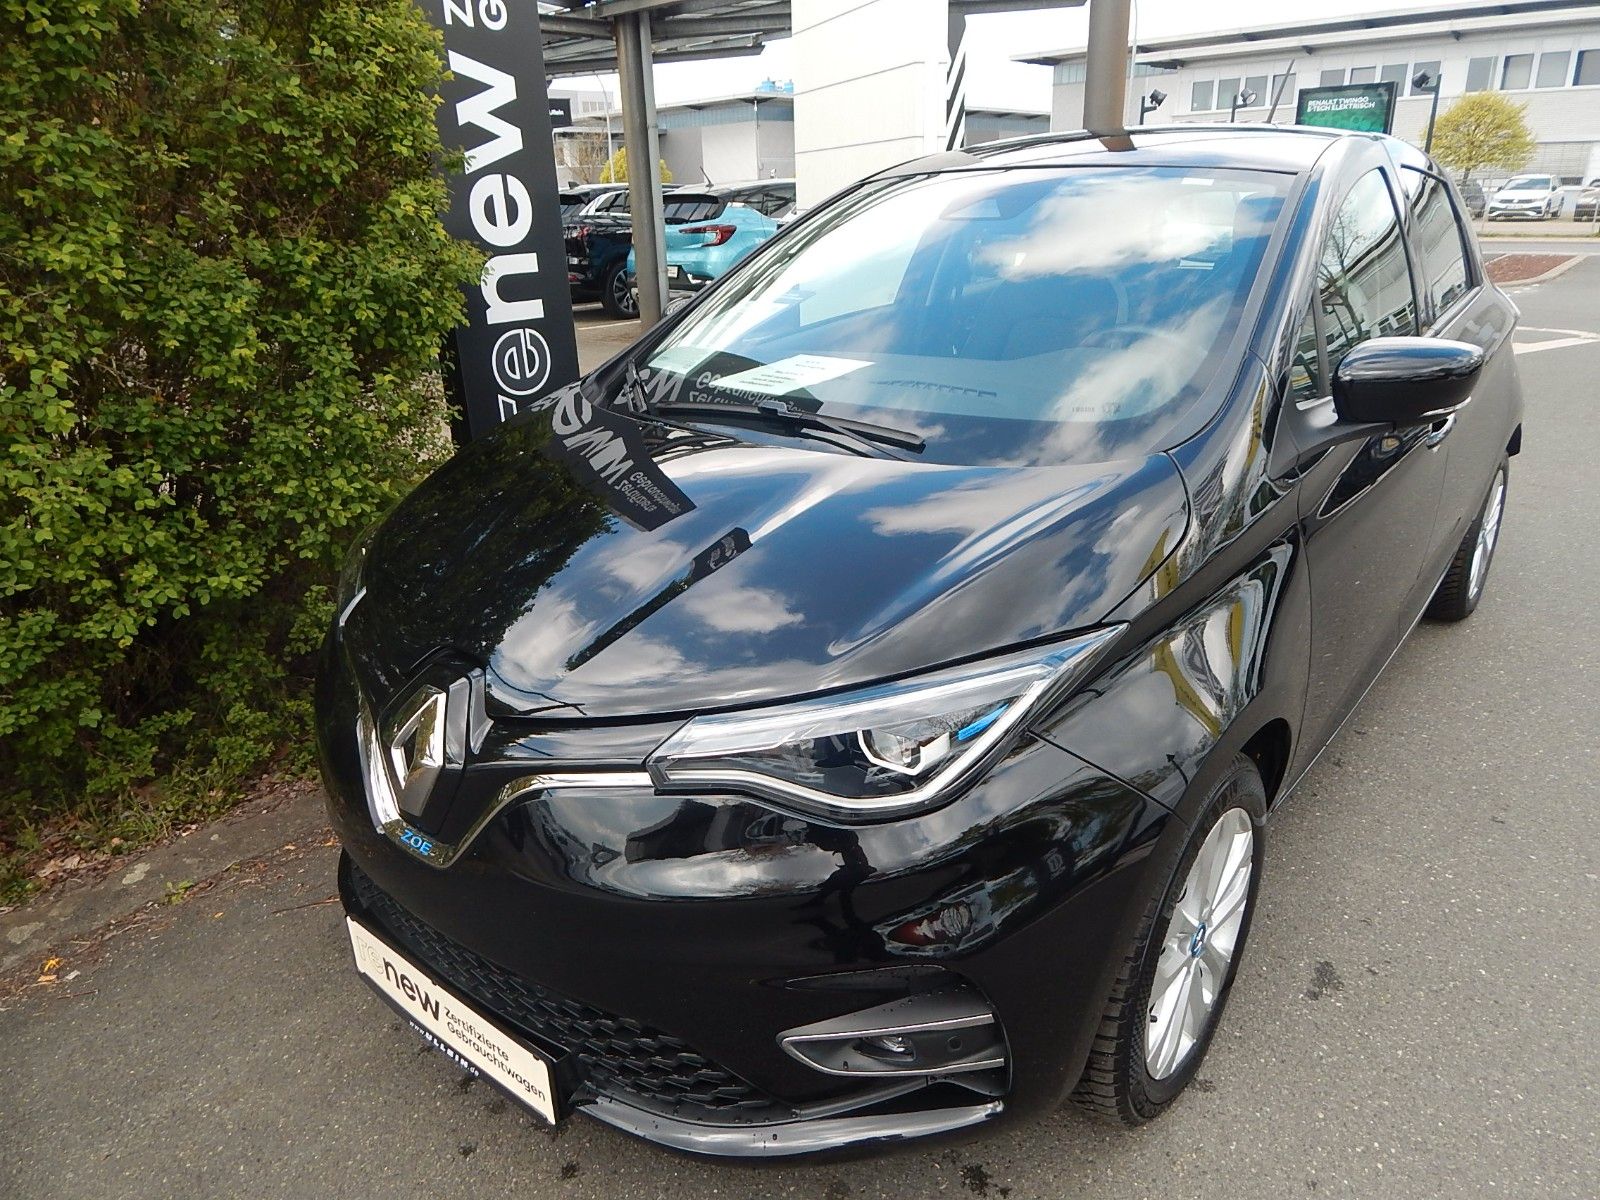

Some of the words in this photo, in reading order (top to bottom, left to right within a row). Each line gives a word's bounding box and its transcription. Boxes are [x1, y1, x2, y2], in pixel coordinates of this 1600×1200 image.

[1308, 98, 1338, 106] RENAULT
[1339, 96, 1369, 104] TWINGO
[1332, 101, 1376, 111] ELEKTRISCH
[401, 829, 432, 856] ZOE
[444, 1006, 509, 1061] Zertifizierte
[447, 1021, 546, 1102] Gebrauchtwagen
